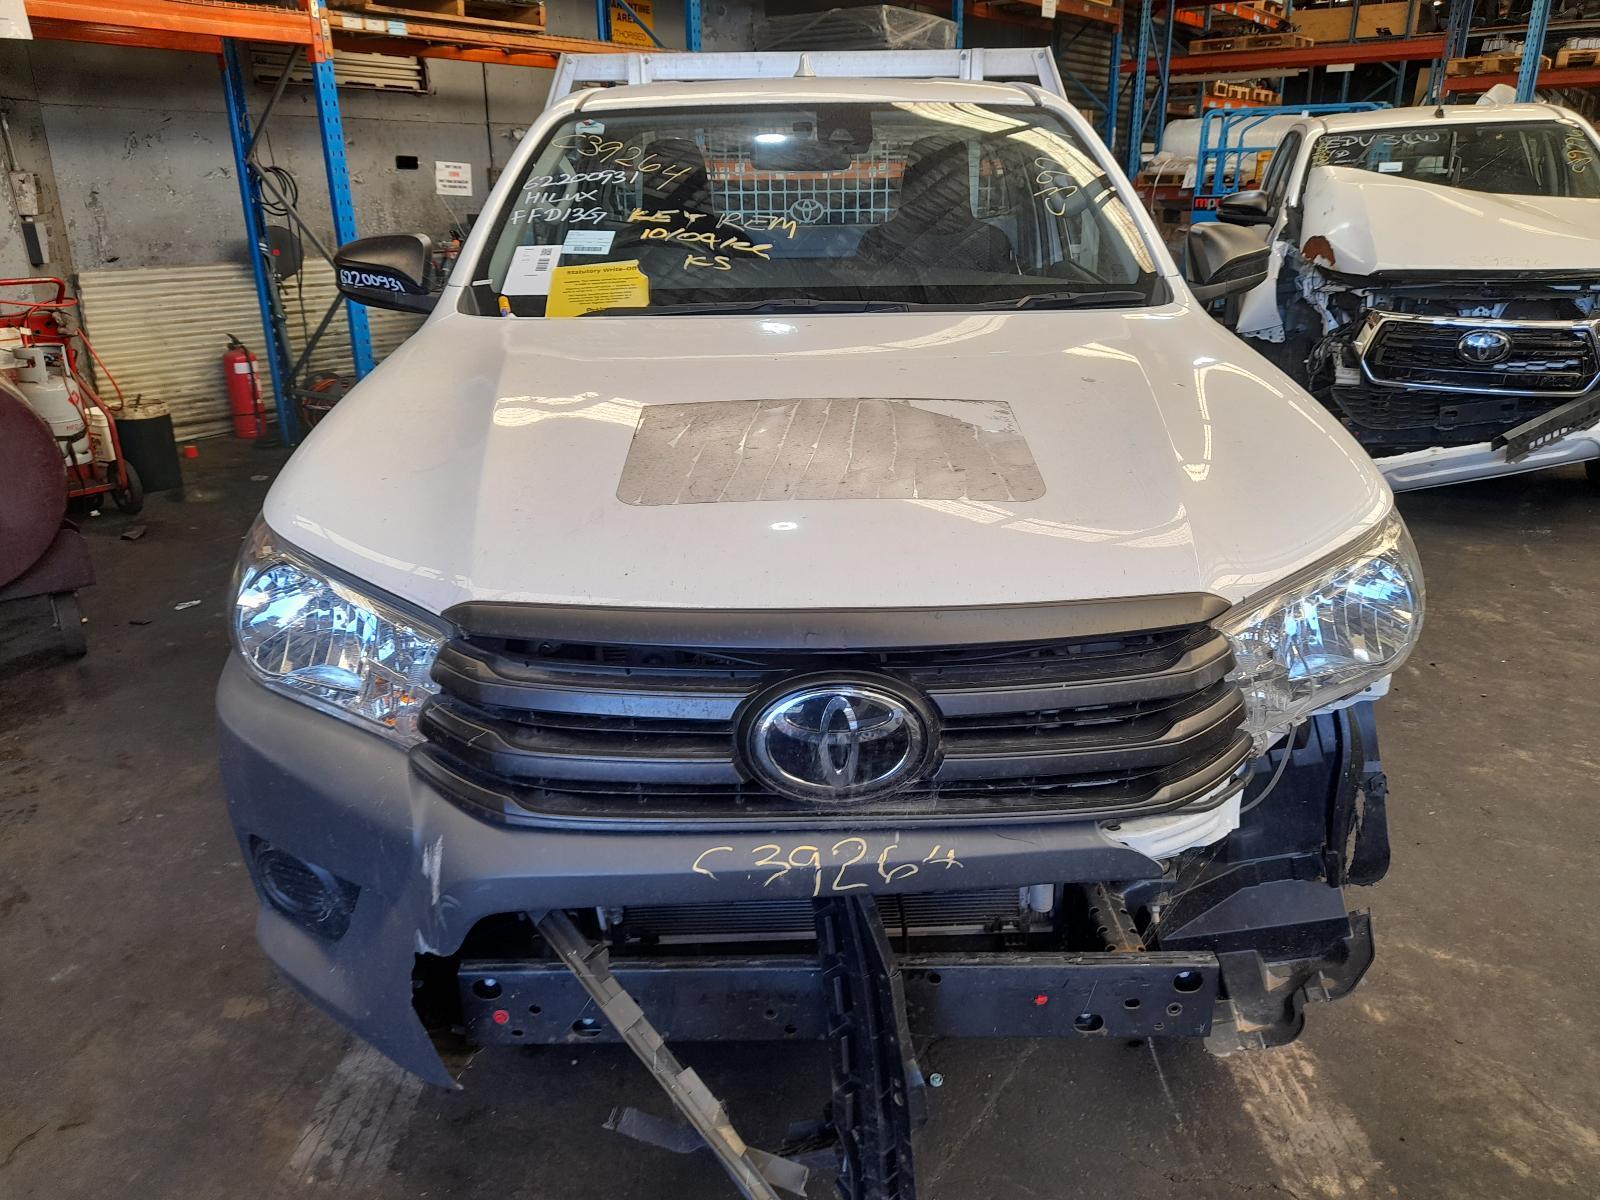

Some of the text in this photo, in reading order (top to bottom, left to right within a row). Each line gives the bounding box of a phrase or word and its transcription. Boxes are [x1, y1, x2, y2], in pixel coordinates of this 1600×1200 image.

[616, 12, 635, 23] ARE
[551, 134, 693, 191] C39264
[522, 170, 639, 191] 62200931
[524, 189, 599, 205] HILUX
[626, 207, 798, 240] KEY REM
[683, 254, 732, 271] KS
[340, 269, 407, 296] 62200931
